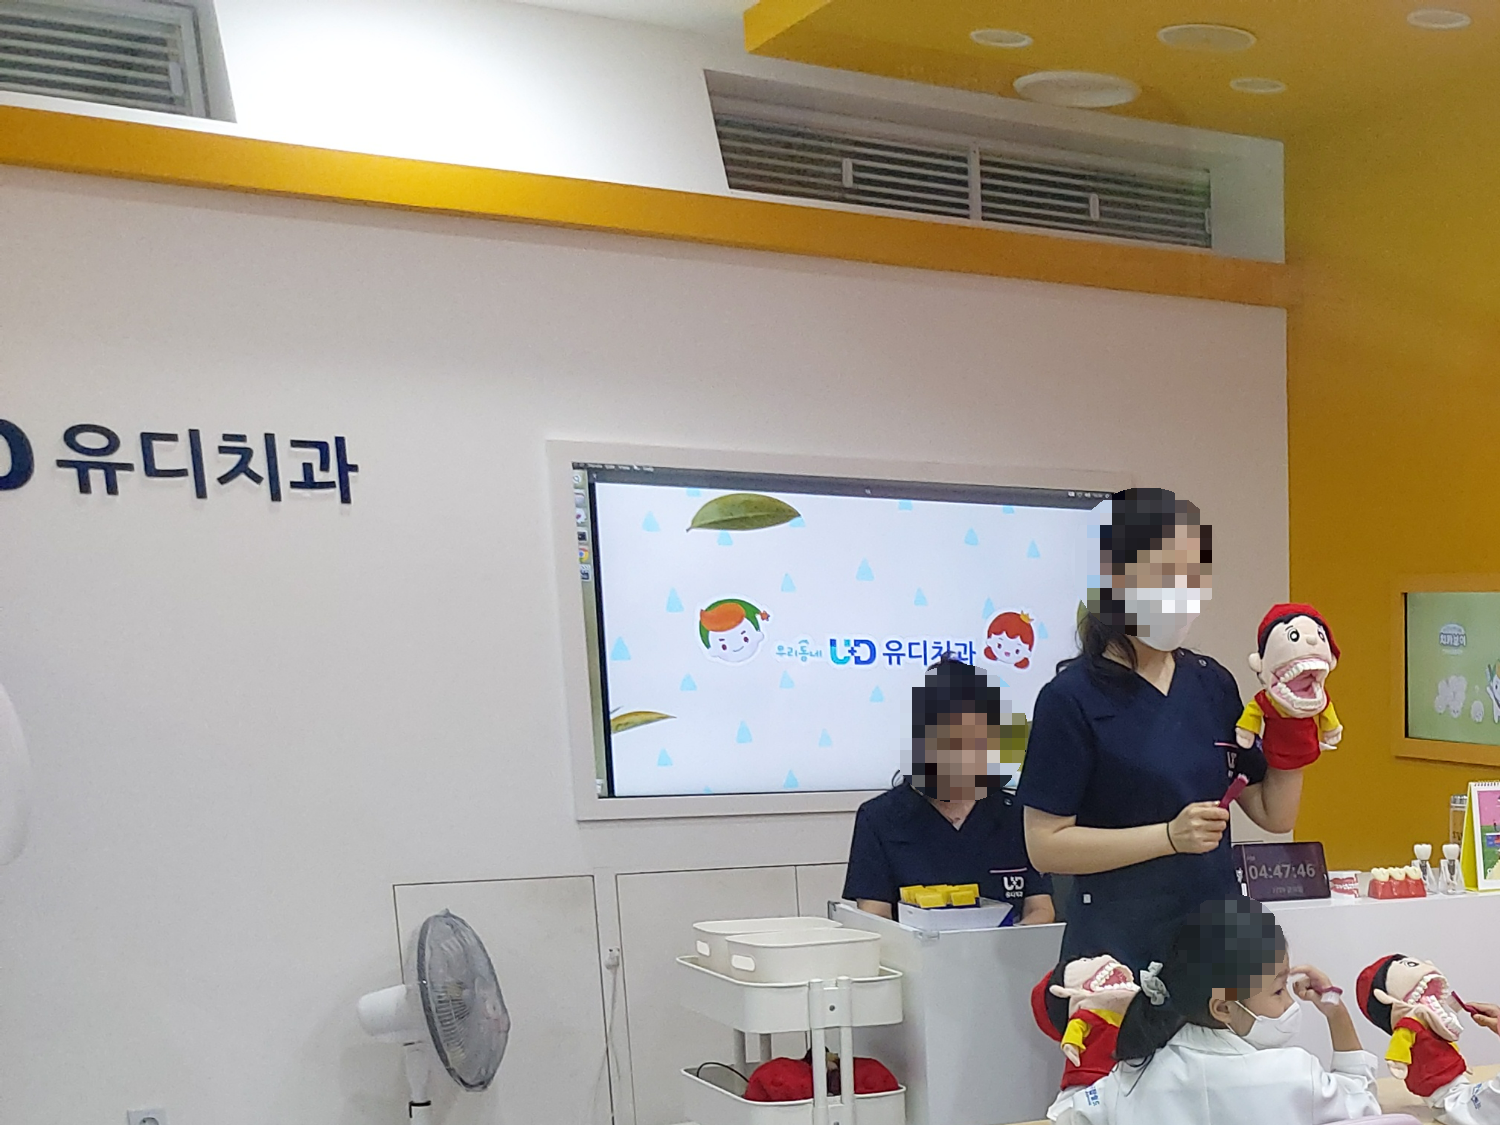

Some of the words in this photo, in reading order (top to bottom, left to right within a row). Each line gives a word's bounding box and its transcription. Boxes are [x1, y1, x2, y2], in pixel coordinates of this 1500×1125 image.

[56, 424, 359, 504] 유디치과
[776, 641, 823, 662] 우리동네
[882, 638, 977, 666] 유디치과
[1248, 863, 1316, 880] 04:47:46
